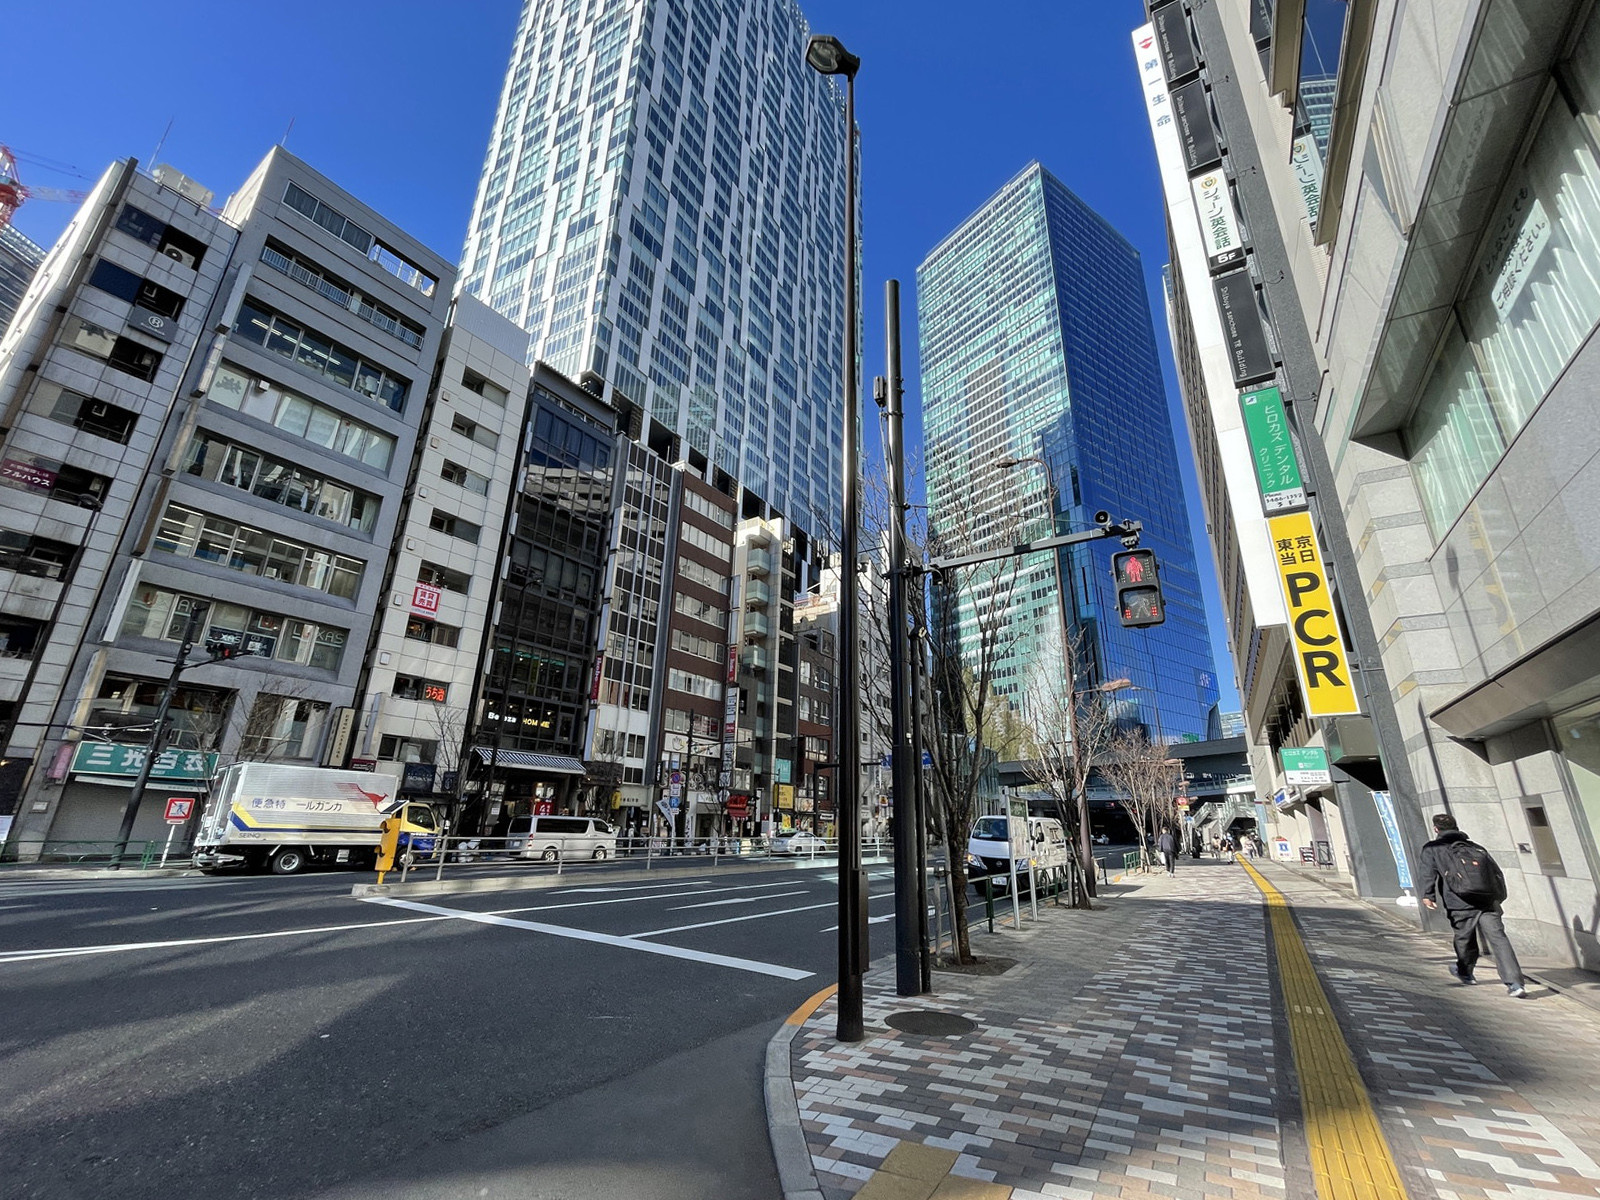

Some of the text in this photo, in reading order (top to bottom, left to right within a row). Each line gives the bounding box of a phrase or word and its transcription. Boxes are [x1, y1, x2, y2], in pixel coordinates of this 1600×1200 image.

[1144, 58, 1171, 127] 第一生命
[1204, 188, 1230, 250] シェーン英会話
[1218, 252, 1236, 263] 5F
[1265, 405, 1294, 486] ヒロカズ デンタル
[2, 468, 50, 487] フルハウス
[1260, 448, 1275, 488] クリニック
[1276, 536, 1313, 551] 東京
[1280, 550, 1315, 566] 当日
[1286, 571, 1346, 689] PCR
